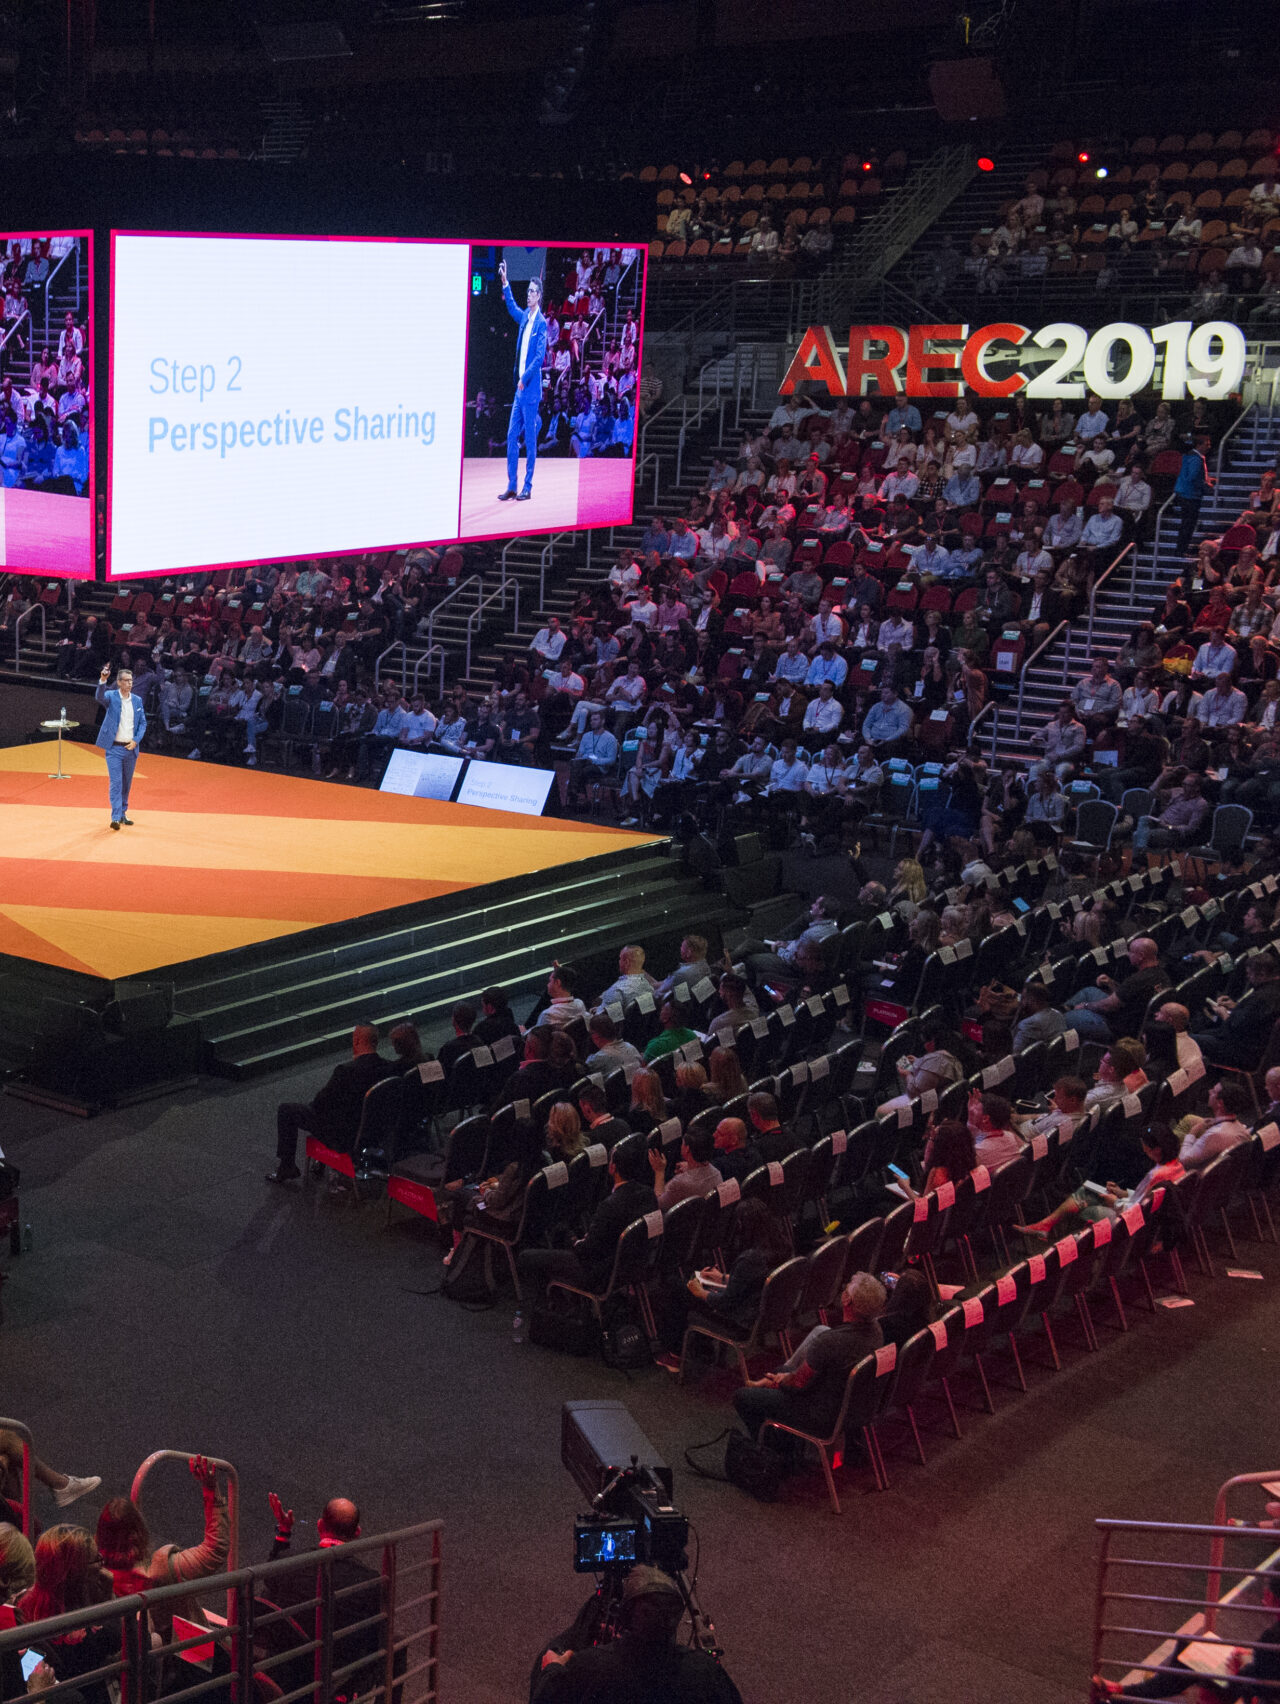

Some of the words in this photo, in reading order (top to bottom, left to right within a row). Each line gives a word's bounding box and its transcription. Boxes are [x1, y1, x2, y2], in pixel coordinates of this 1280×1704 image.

[150, 358, 216, 403] Step
[227, 356, 242, 392] 2
[777, 321, 1246, 400] AREC2019
[148, 410, 325, 459] Perspective
[333, 404, 436, 446] Sharing
[466, 788, 509, 801] Perspective
[509, 794, 538, 806] Sharing
